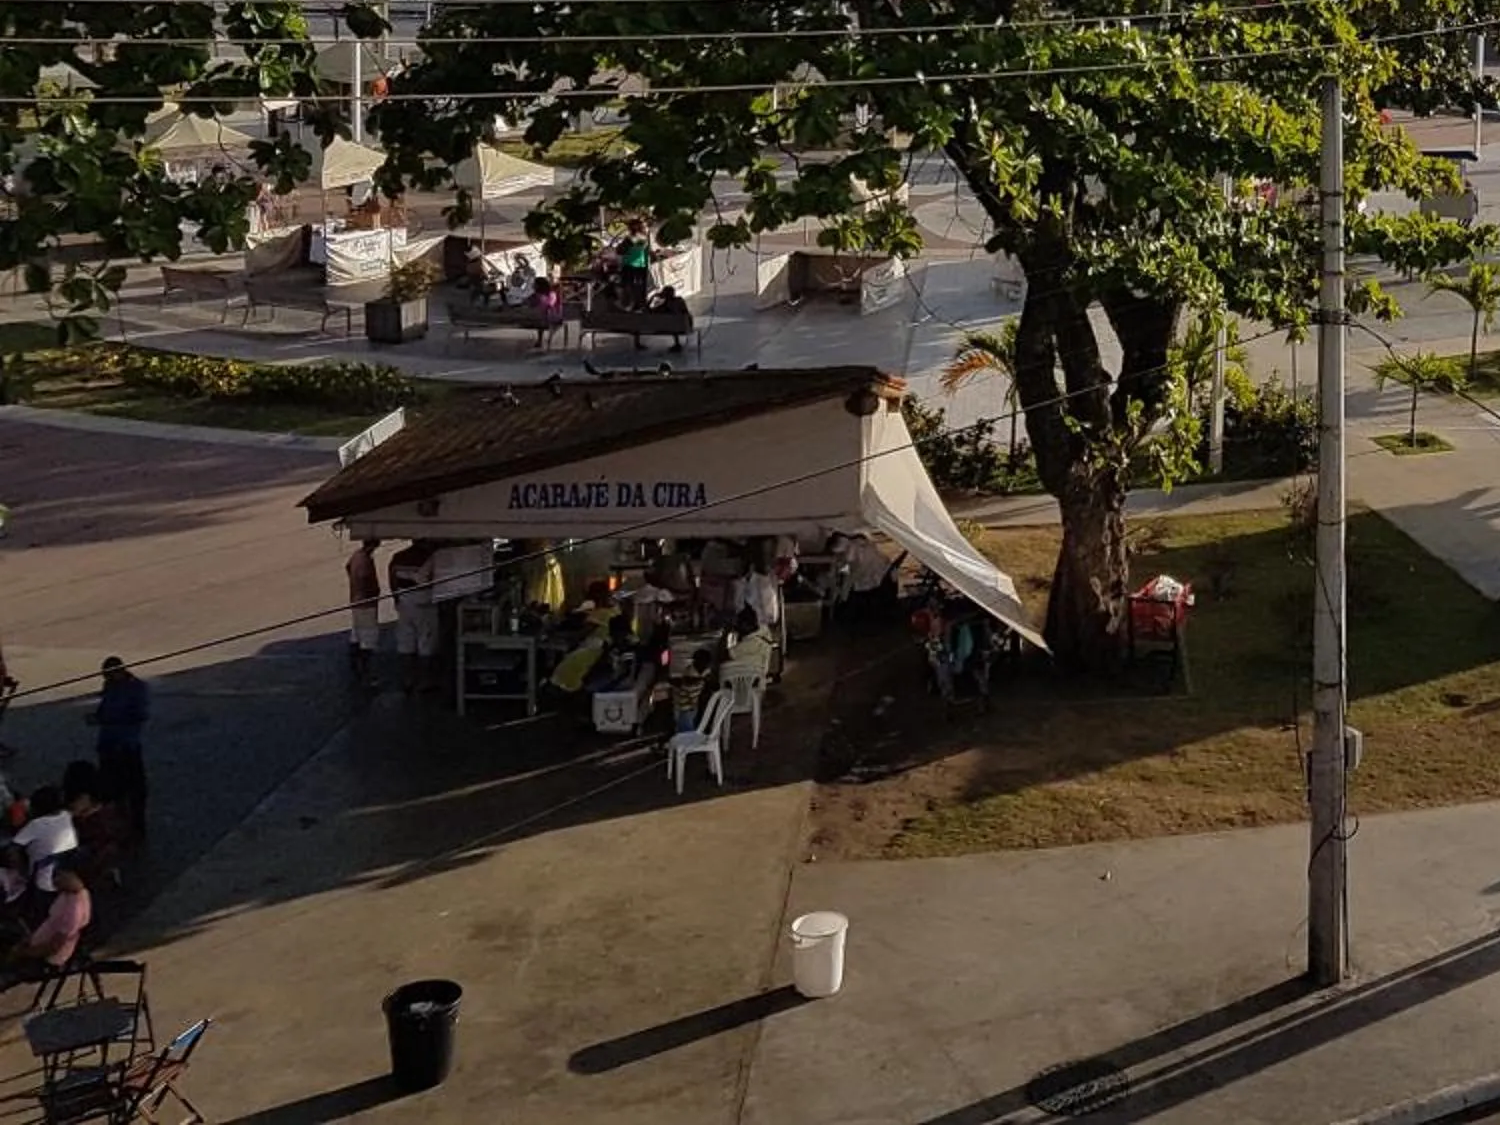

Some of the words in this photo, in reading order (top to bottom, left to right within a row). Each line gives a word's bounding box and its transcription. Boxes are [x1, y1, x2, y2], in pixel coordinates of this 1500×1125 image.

[508, 474, 609, 509] ACARAJÉ
[615, 482, 647, 508] DA
[652, 482, 707, 508] CIRA
